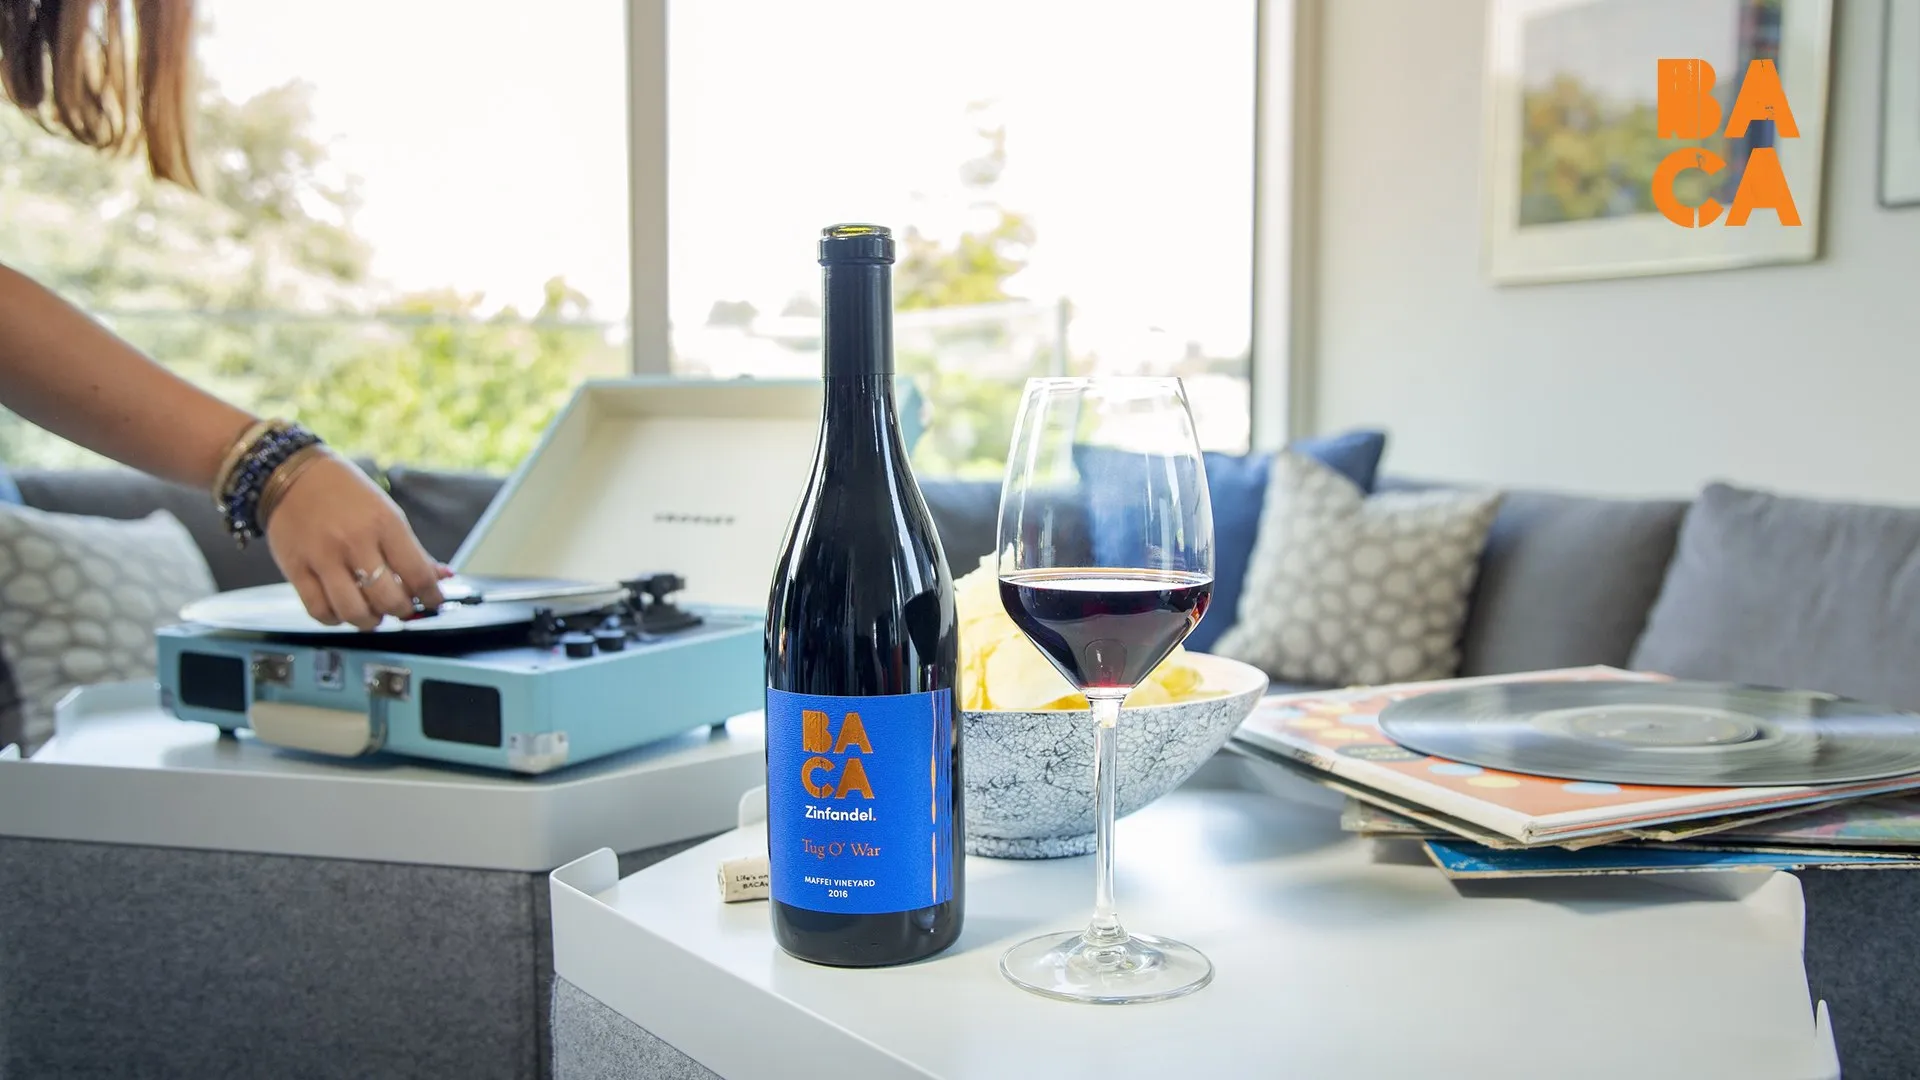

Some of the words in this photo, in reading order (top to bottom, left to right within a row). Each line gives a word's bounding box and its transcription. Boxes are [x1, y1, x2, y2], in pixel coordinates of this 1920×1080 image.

[802, 710, 874, 753] BA
[801, 756, 875, 799] CA
[805, 805, 877, 821] Zinfandel.
[802, 839, 826, 860] Tug
[851, 842, 881, 857] War
[804, 876, 832, 886] MAFFEI
[834, 879, 876, 887] VINEYARD
[828, 889, 848, 898] 2016
